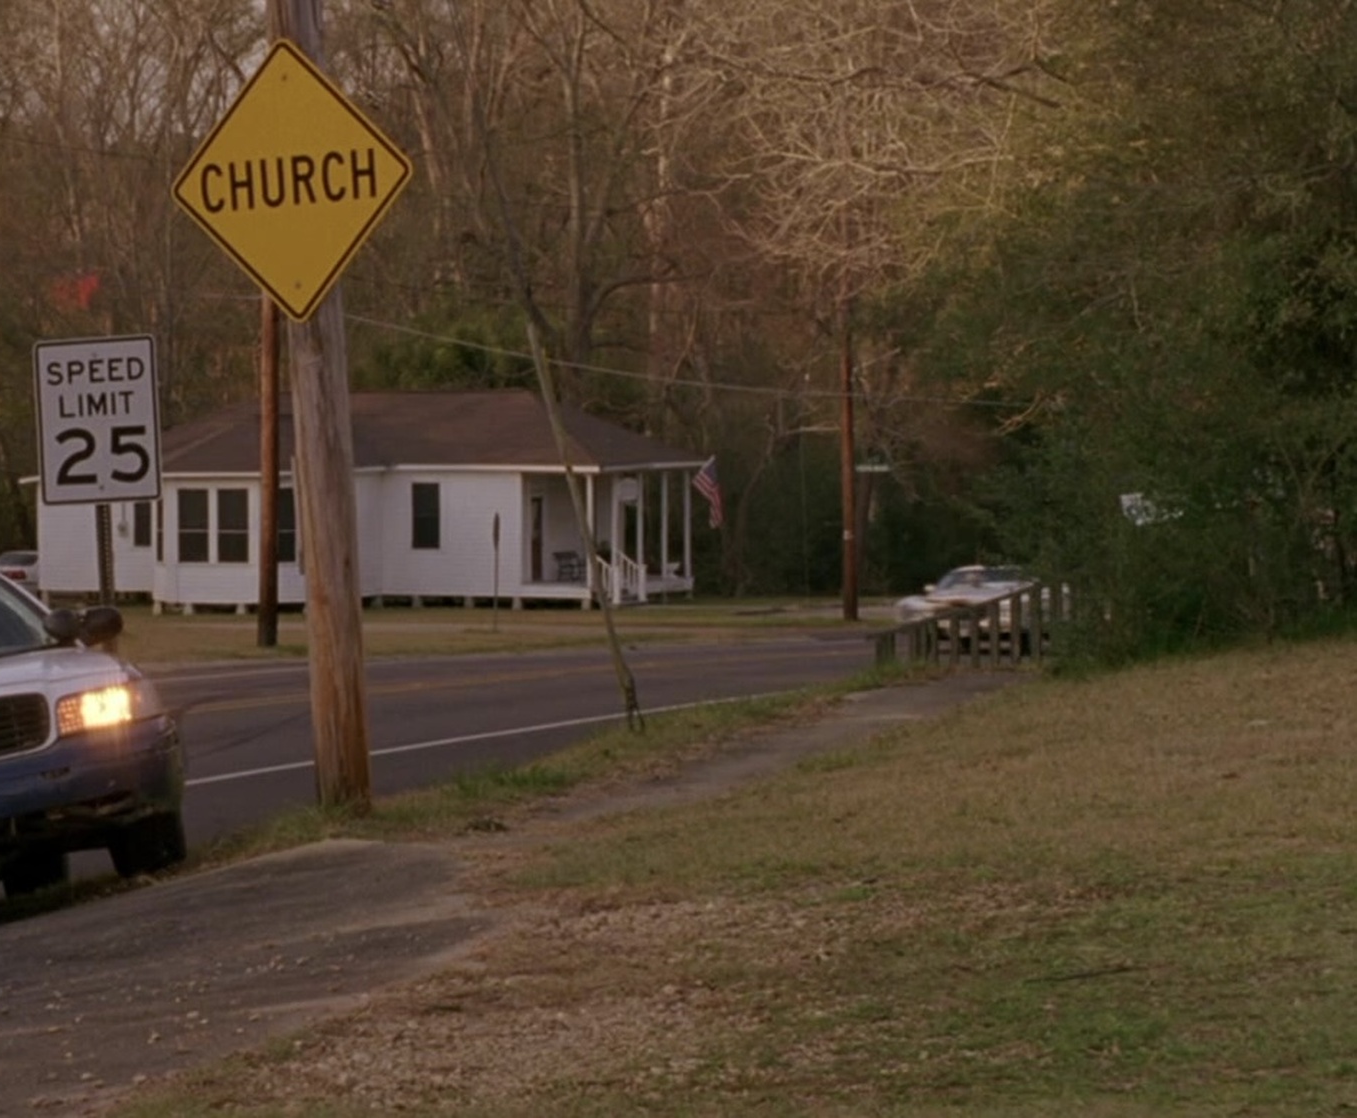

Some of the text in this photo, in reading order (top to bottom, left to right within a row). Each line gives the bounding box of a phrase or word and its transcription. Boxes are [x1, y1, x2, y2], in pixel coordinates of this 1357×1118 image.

[200, 148, 378, 213] CHURCH
[47, 357, 145, 386] SPEED
[59, 391, 134, 418] LIMIT
[55, 425, 150, 486] 25
